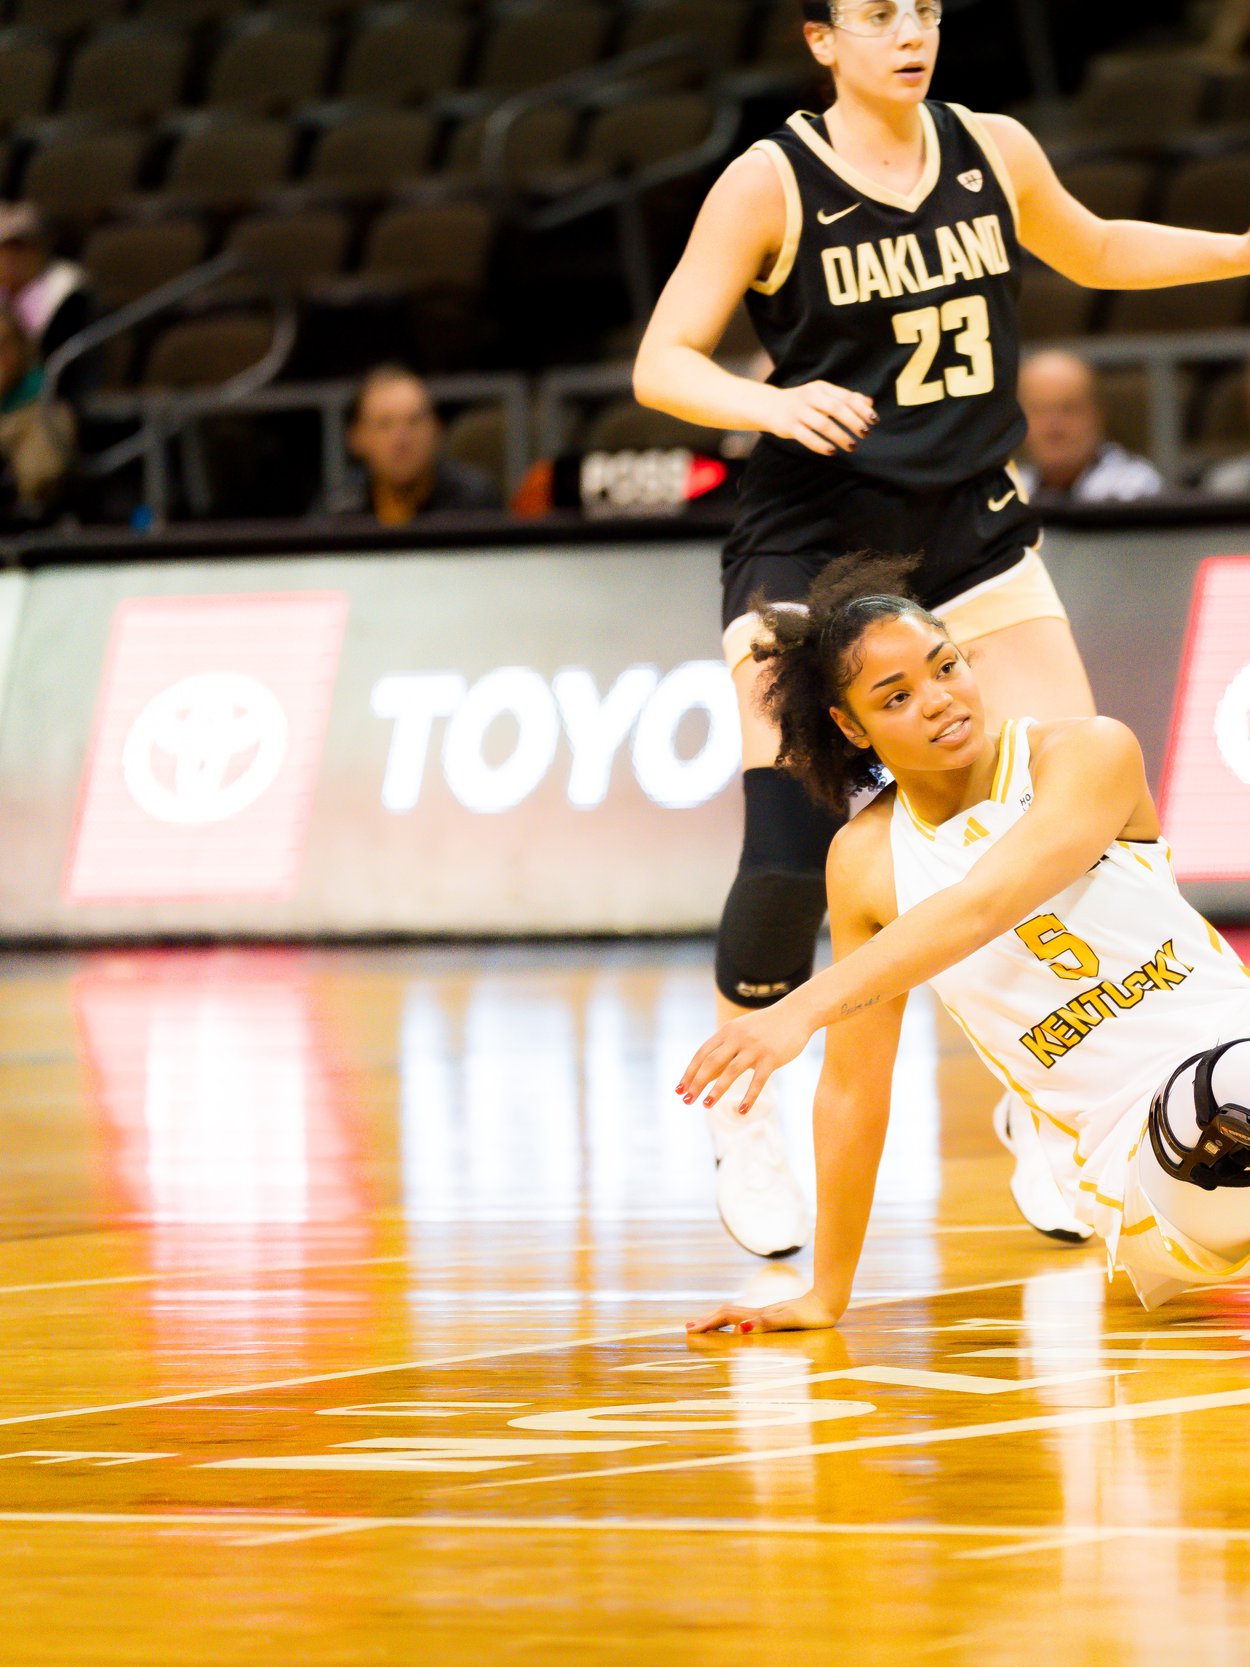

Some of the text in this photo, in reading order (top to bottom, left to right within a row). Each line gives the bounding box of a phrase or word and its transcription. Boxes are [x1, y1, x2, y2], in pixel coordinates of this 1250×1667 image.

[820, 214, 1010, 305] OAKLAND
[892, 294, 994, 406] 23
[369, 658, 744, 814] TOYO
[1014, 912, 1100, 981] 5
[1018, 938, 1195, 1070] KENTUCKY
